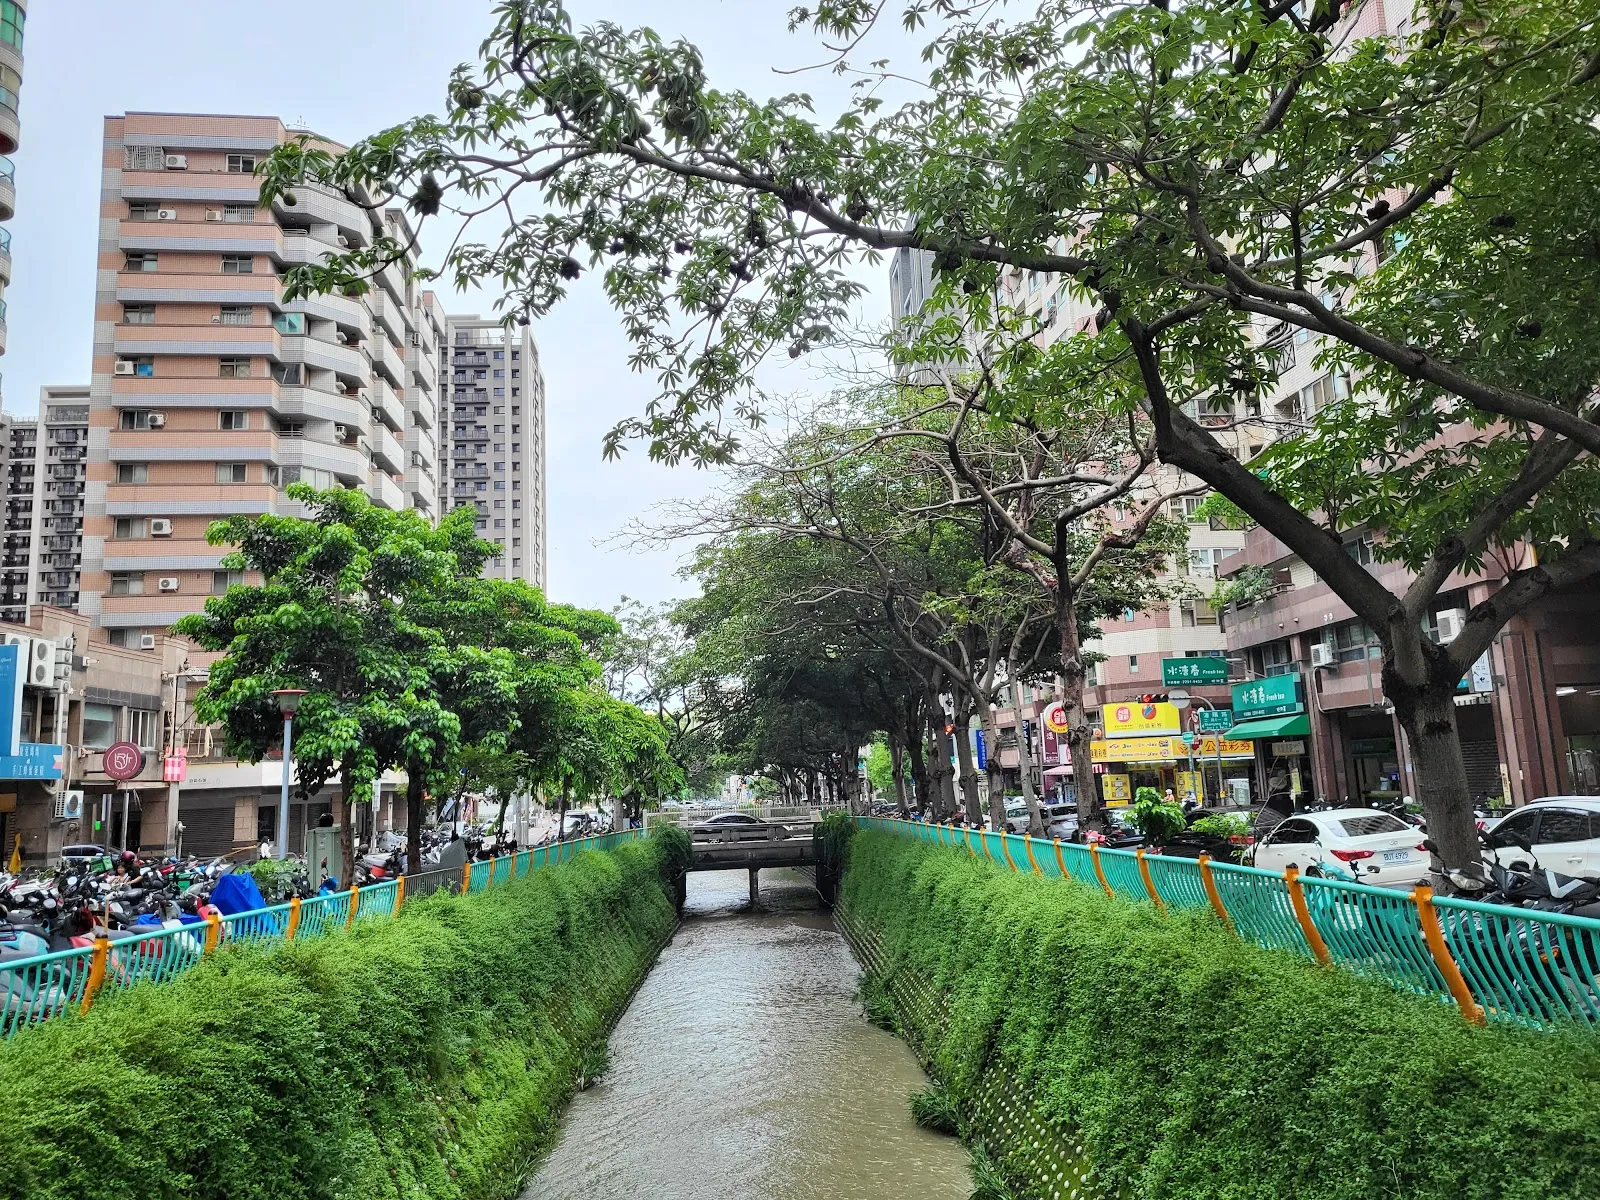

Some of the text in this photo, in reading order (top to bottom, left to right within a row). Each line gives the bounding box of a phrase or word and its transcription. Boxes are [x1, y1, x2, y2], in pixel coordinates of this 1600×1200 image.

[1266, 692, 1285, 702] Fresh tea
[1205, 740, 1251, 752] 公益彩券
